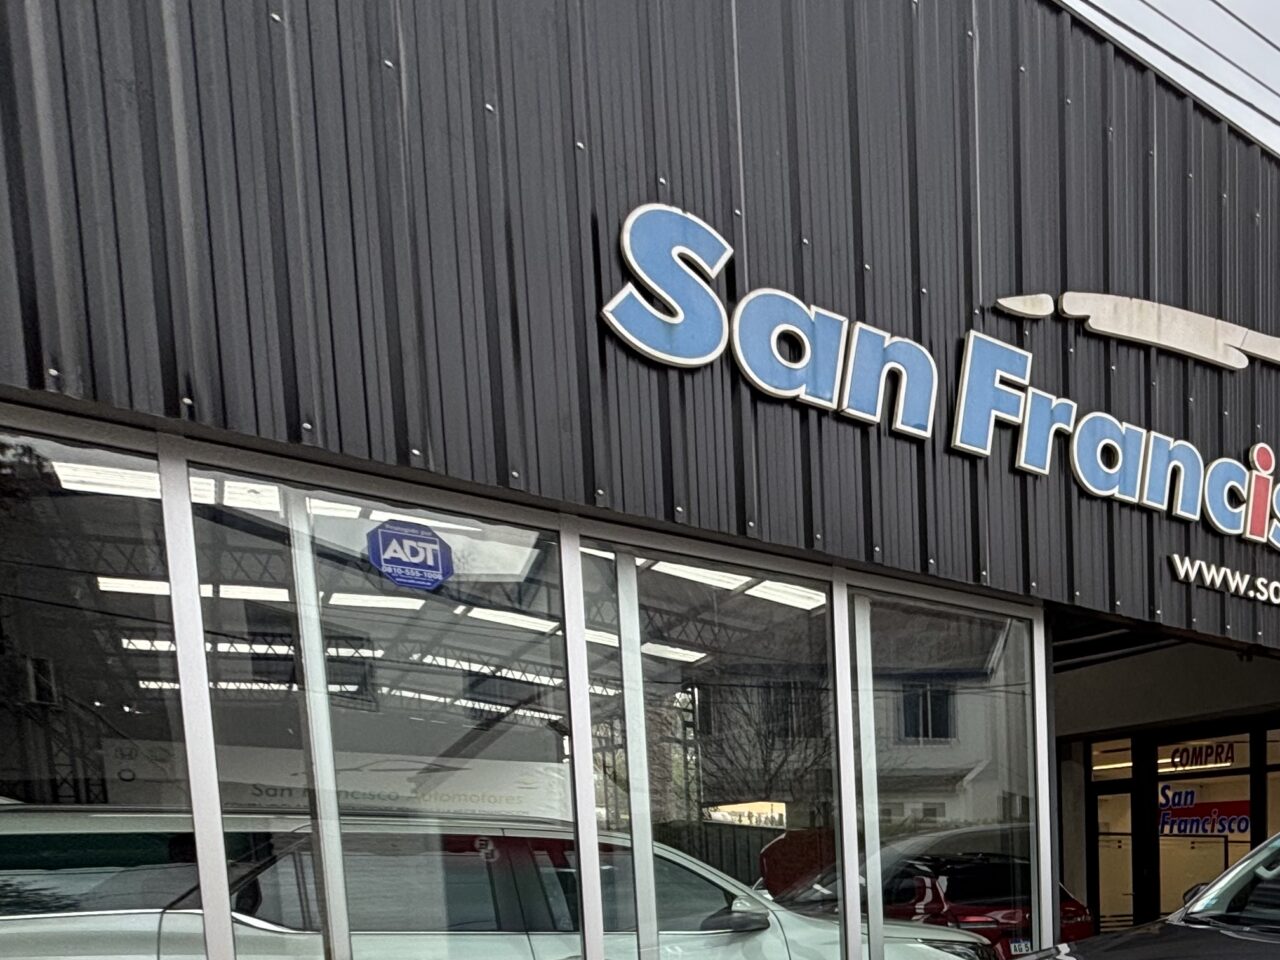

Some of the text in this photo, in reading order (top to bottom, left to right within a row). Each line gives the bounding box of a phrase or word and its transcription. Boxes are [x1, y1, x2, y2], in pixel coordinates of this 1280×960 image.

[602, 202, 938, 439] San
[383, 538, 439, 567] ADT
[1171, 743, 1235, 768] COMPRA
[1159, 785, 1196, 809] San
[1159, 808, 1250, 834] Francisco
